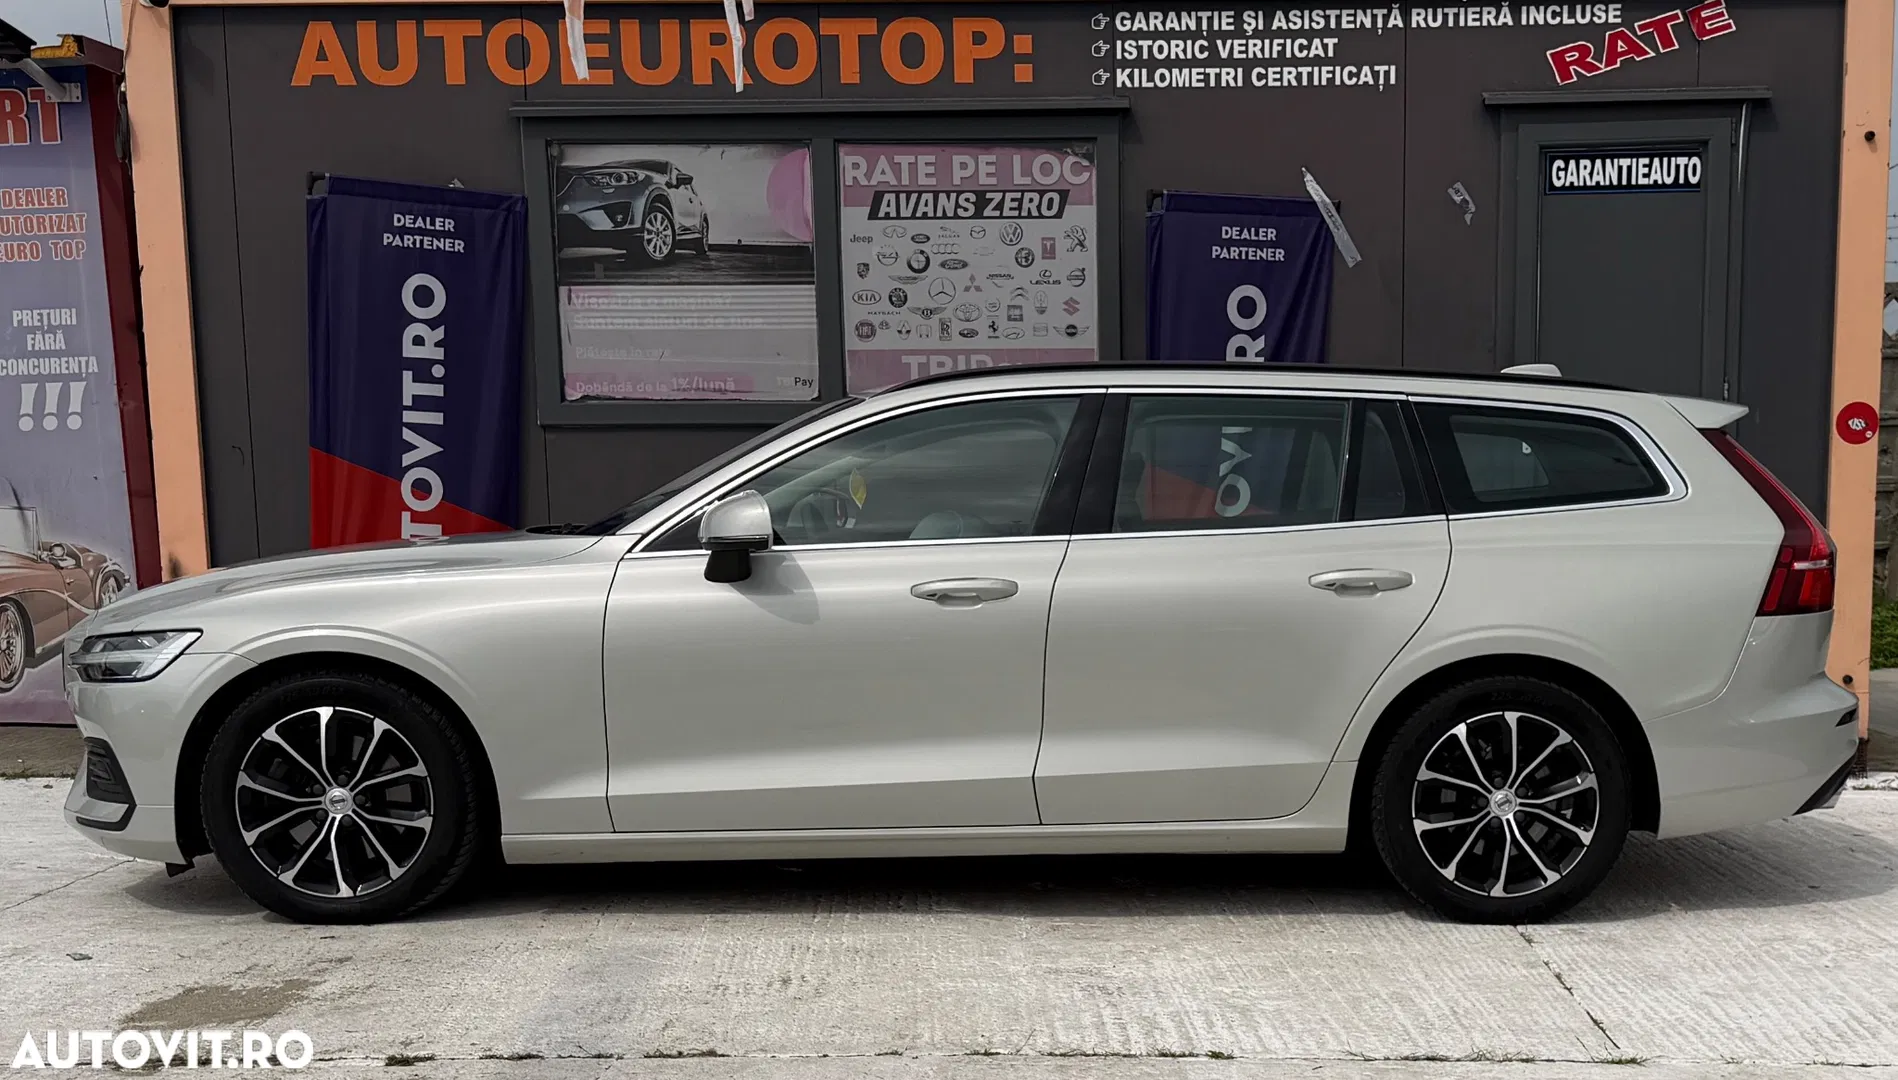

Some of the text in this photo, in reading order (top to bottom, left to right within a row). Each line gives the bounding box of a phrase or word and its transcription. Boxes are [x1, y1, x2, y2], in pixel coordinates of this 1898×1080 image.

[1411, 2, 1514, 28] RUTIERĂ
[1521, 4, 1622, 25] INCLUSE
[290, 17, 1034, 86] AUTOEUROTOP:
[1116, 37, 1339, 60] ISTORIC VERIFICAT
[1546, 0, 1737, 86] RATE
[1116, 68, 1243, 88] KILOMETRI
[843, 153, 1092, 187] RATE PE LOC
[1552, 156, 1702, 187] GARANTIEAUTO
[0, 187, 68, 209] DEALER
[877, 191, 1061, 219] AVANS ZERO
[393, 213, 455, 232] DEALER
[383, 233, 465, 253] PARTENER
[849, 234, 874, 244] Jeep
[1221, 226, 1277, 241] DEALER
[48, 239, 87, 261] TOP
[1211, 245, 1286, 262] PARTENER
[857, 293, 877, 302] KIA
[26, 330, 66, 351] FĂRĂ
[637, 382, 653, 393] de
